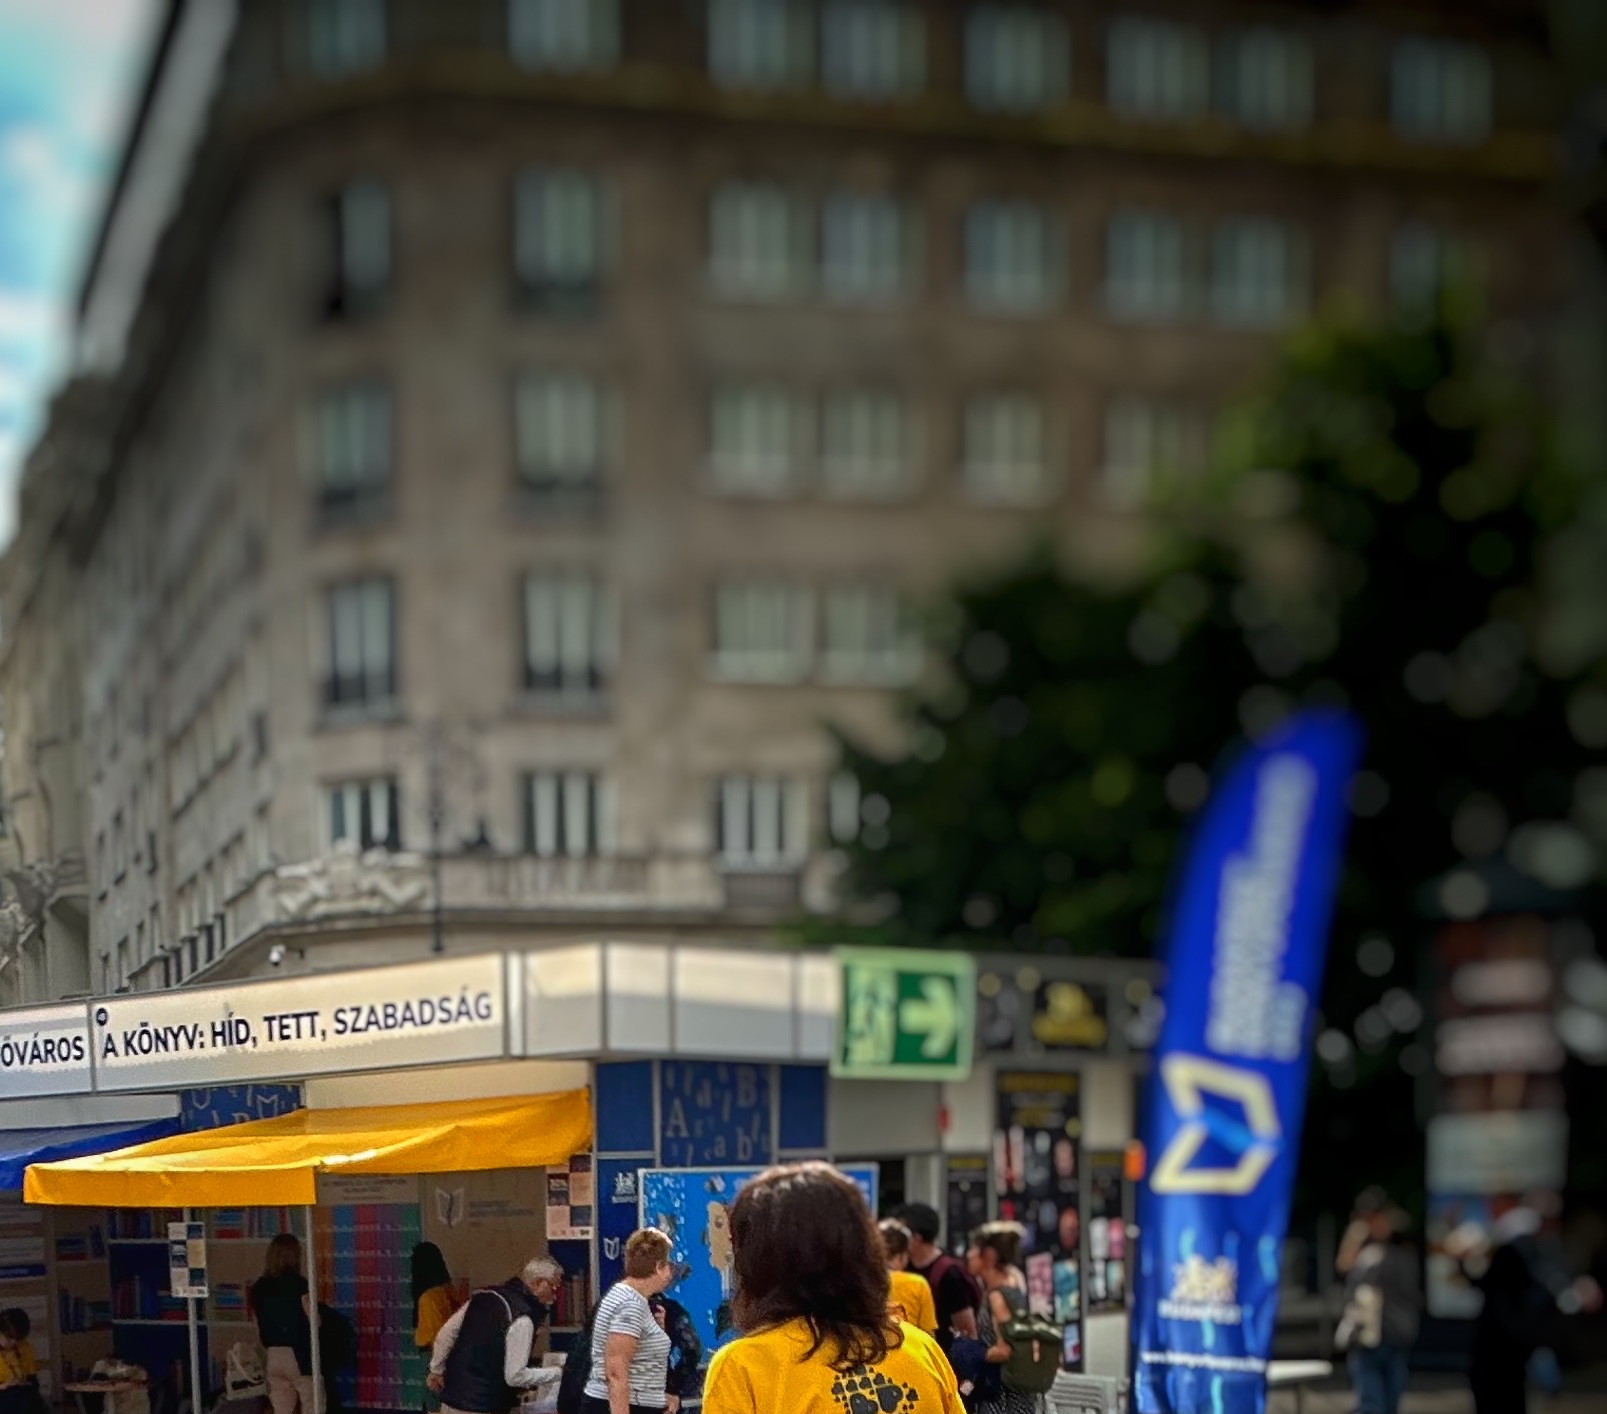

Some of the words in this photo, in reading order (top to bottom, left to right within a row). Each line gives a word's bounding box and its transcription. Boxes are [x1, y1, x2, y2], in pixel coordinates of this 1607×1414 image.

[103, 1034, 119, 1059] A
[124, 1022, 205, 1056] KÖNYV:
[211, 1011, 257, 1048] HÍD,
[263, 1011, 326, 1042] TETT,
[334, 988, 492, 1035] SZABADSÁG
